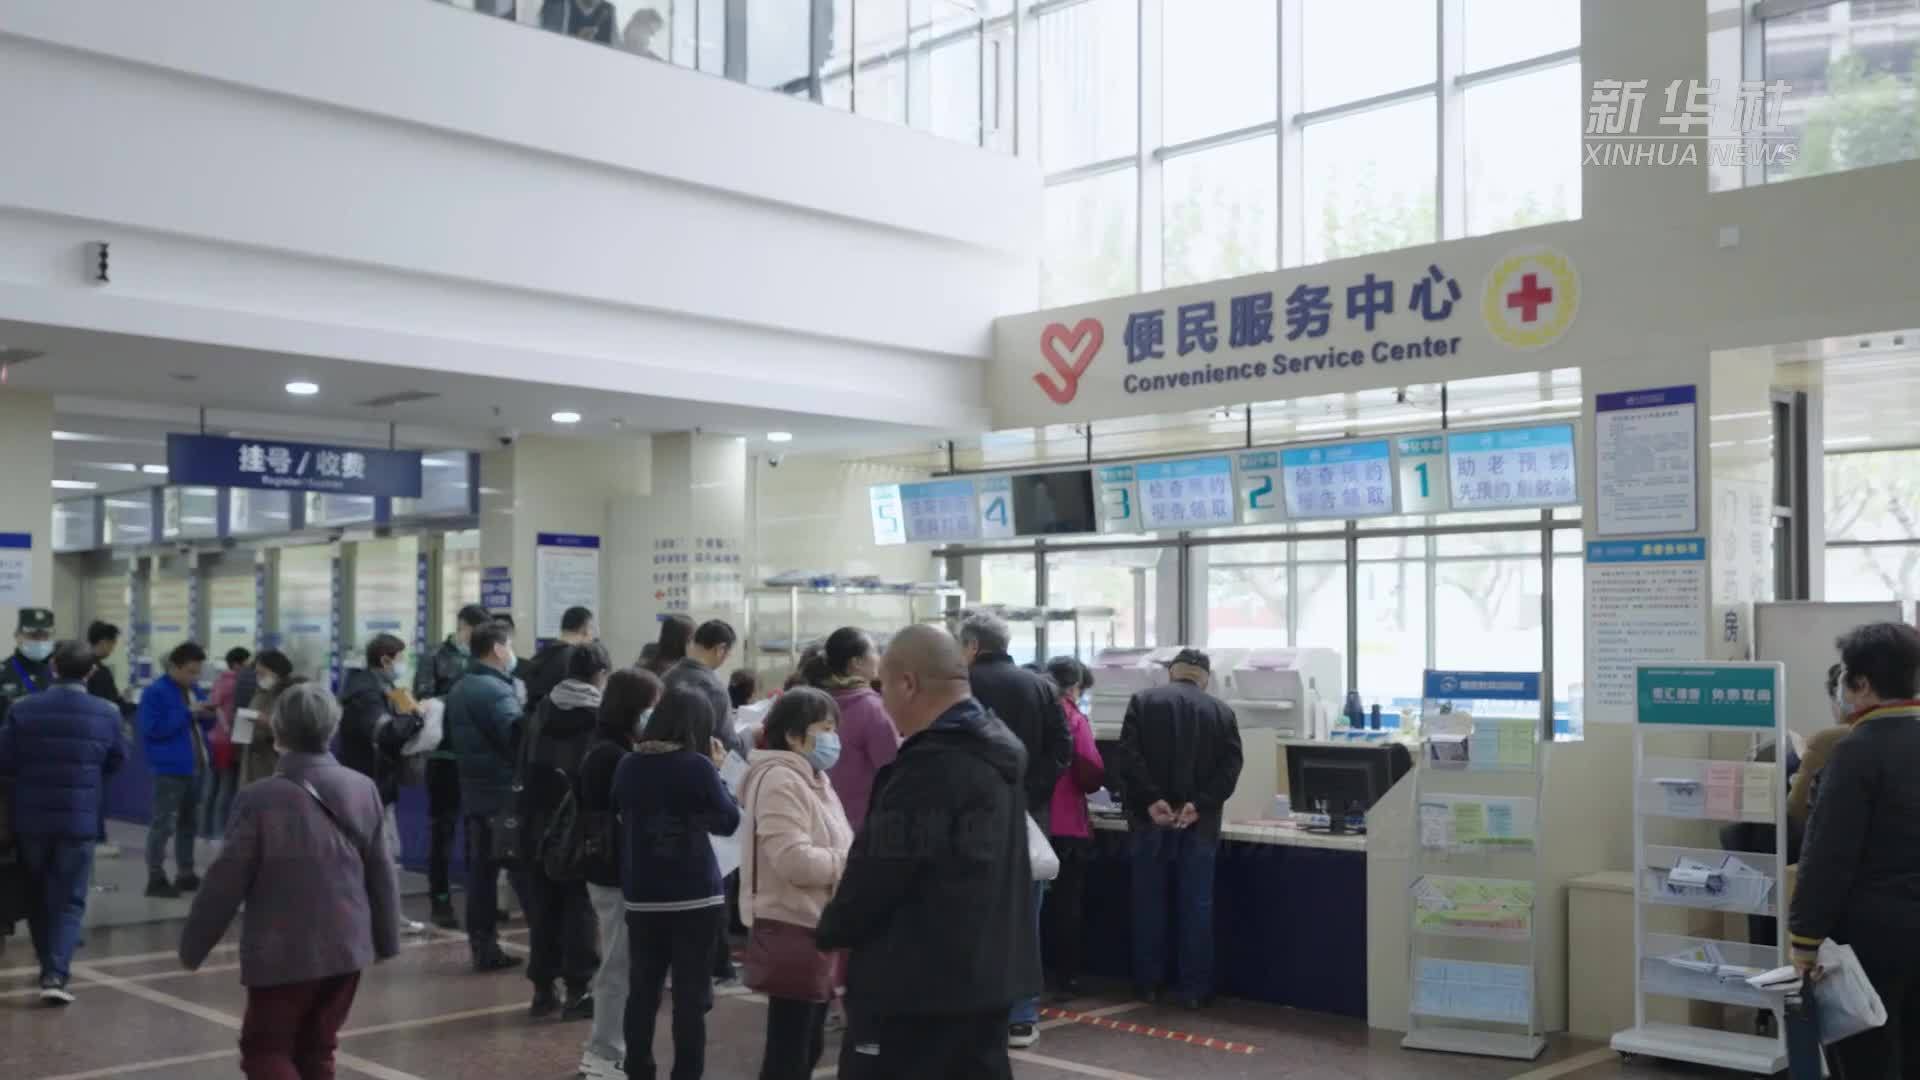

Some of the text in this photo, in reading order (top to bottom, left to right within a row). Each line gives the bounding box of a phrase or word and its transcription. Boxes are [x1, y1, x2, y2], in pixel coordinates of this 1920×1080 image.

[1124, 265, 1462, 364] 便民服务中心
[1123, 336, 1461, 394] Convenience Service Center
[1247, 475, 1275, 510] 2
[1413, 462, 1431, 498] 1
[878, 502, 898, 534] 5
[984, 495, 1008, 528] 4
[1102, 487, 1130, 520] 3
